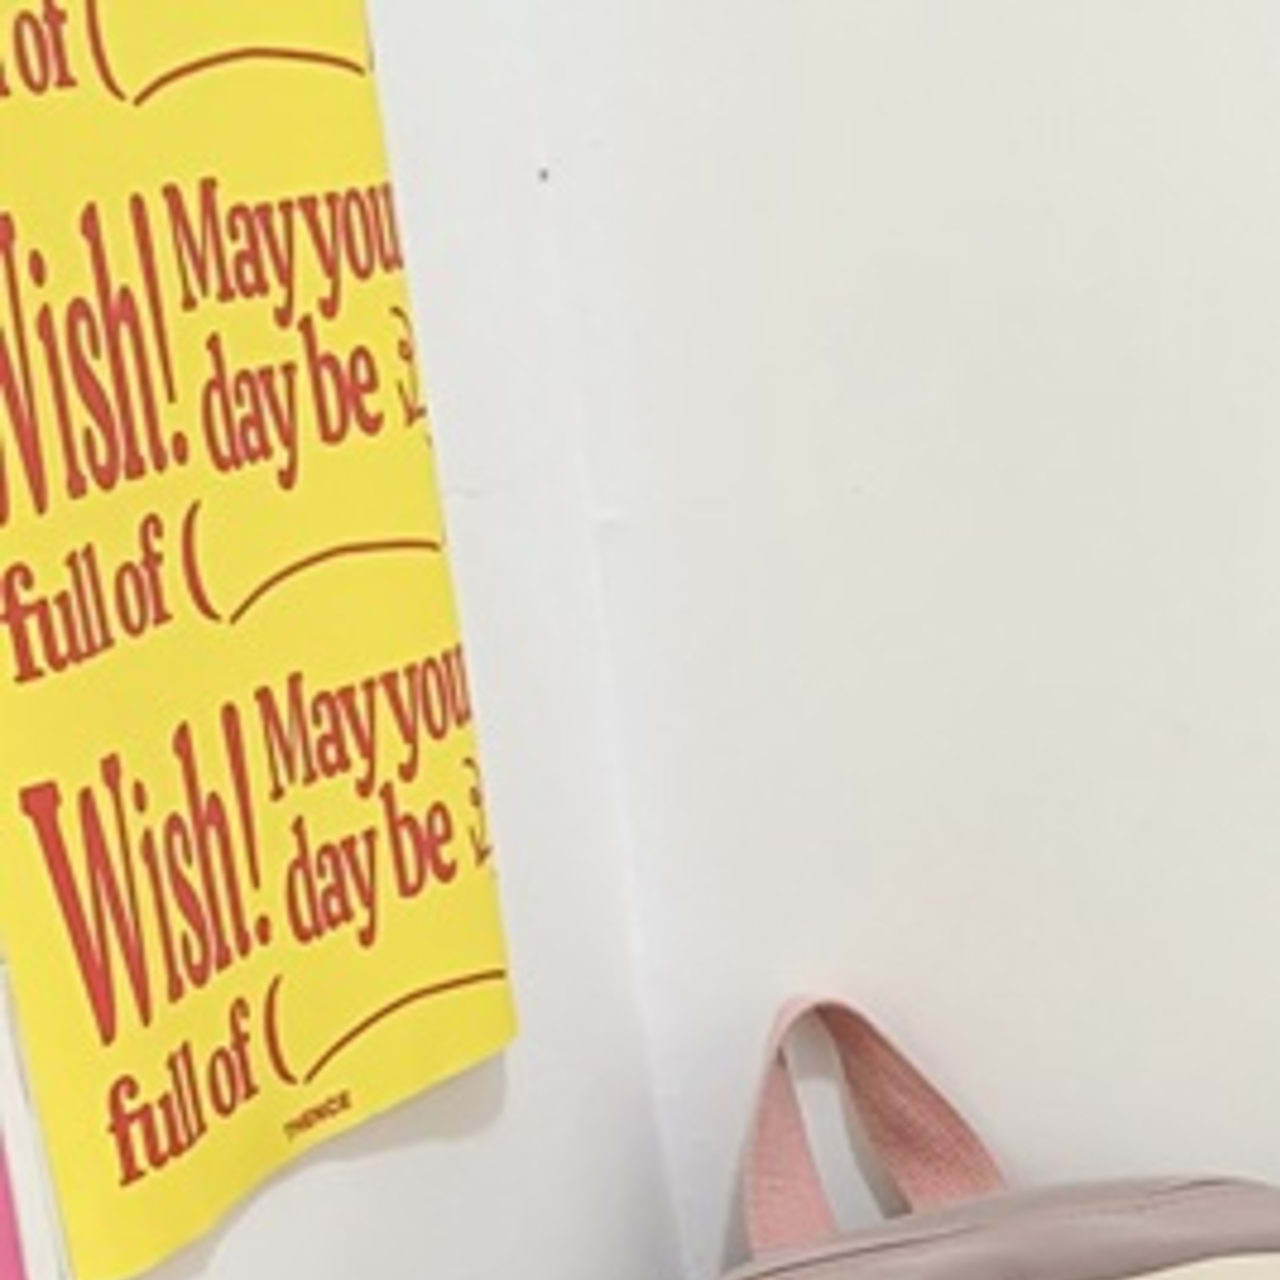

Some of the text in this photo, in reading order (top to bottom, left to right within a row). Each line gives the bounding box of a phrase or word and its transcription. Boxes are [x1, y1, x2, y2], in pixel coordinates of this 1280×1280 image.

[163, 177, 296, 329] May
[201, 314, 384, 490] day be
[0, 541, 115, 683] full
[114, 513, 172, 637] of
[20, 702, 270, 1046] Wish!
[255, 671, 378, 800] May
[286, 782, 457, 947] day be
[107, 1040, 207, 1187] full
[207, 997, 259, 1117] of
